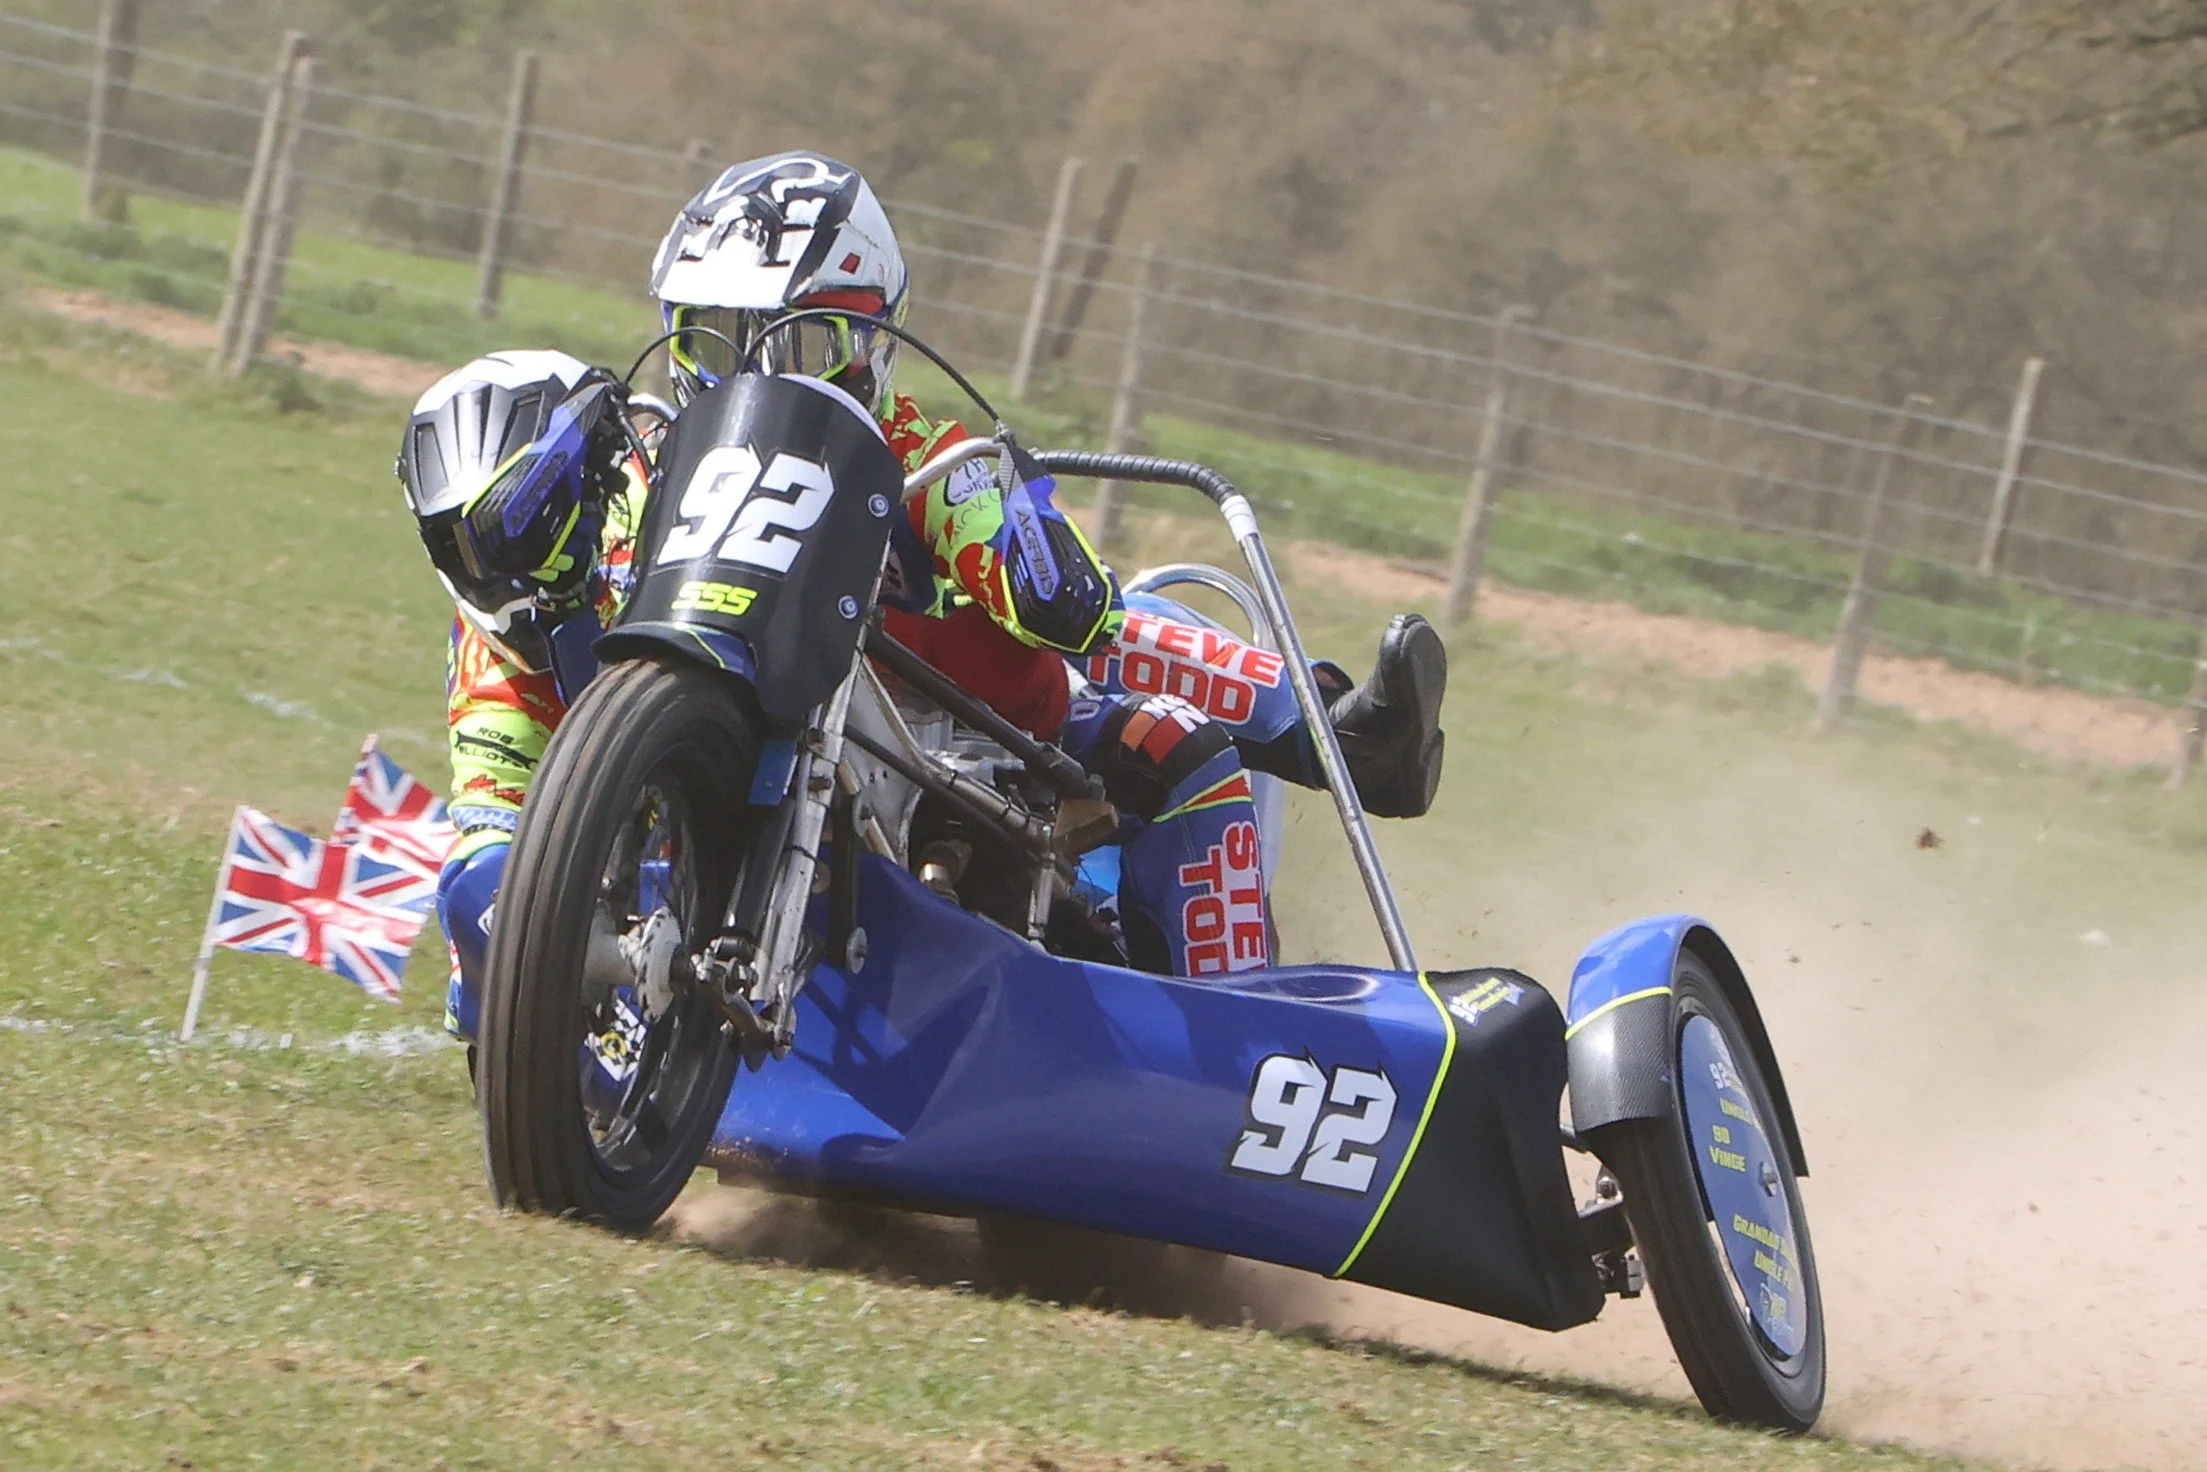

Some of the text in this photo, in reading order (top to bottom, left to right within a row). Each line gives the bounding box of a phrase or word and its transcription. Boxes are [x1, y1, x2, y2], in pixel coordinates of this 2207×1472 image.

[657, 443, 835, 573] 92
[1121, 616, 1285, 687] TEVE
[1181, 847, 1230, 977] TOD
[1224, 822, 1267, 971] STE
[1231, 1057, 1398, 1192] 92
